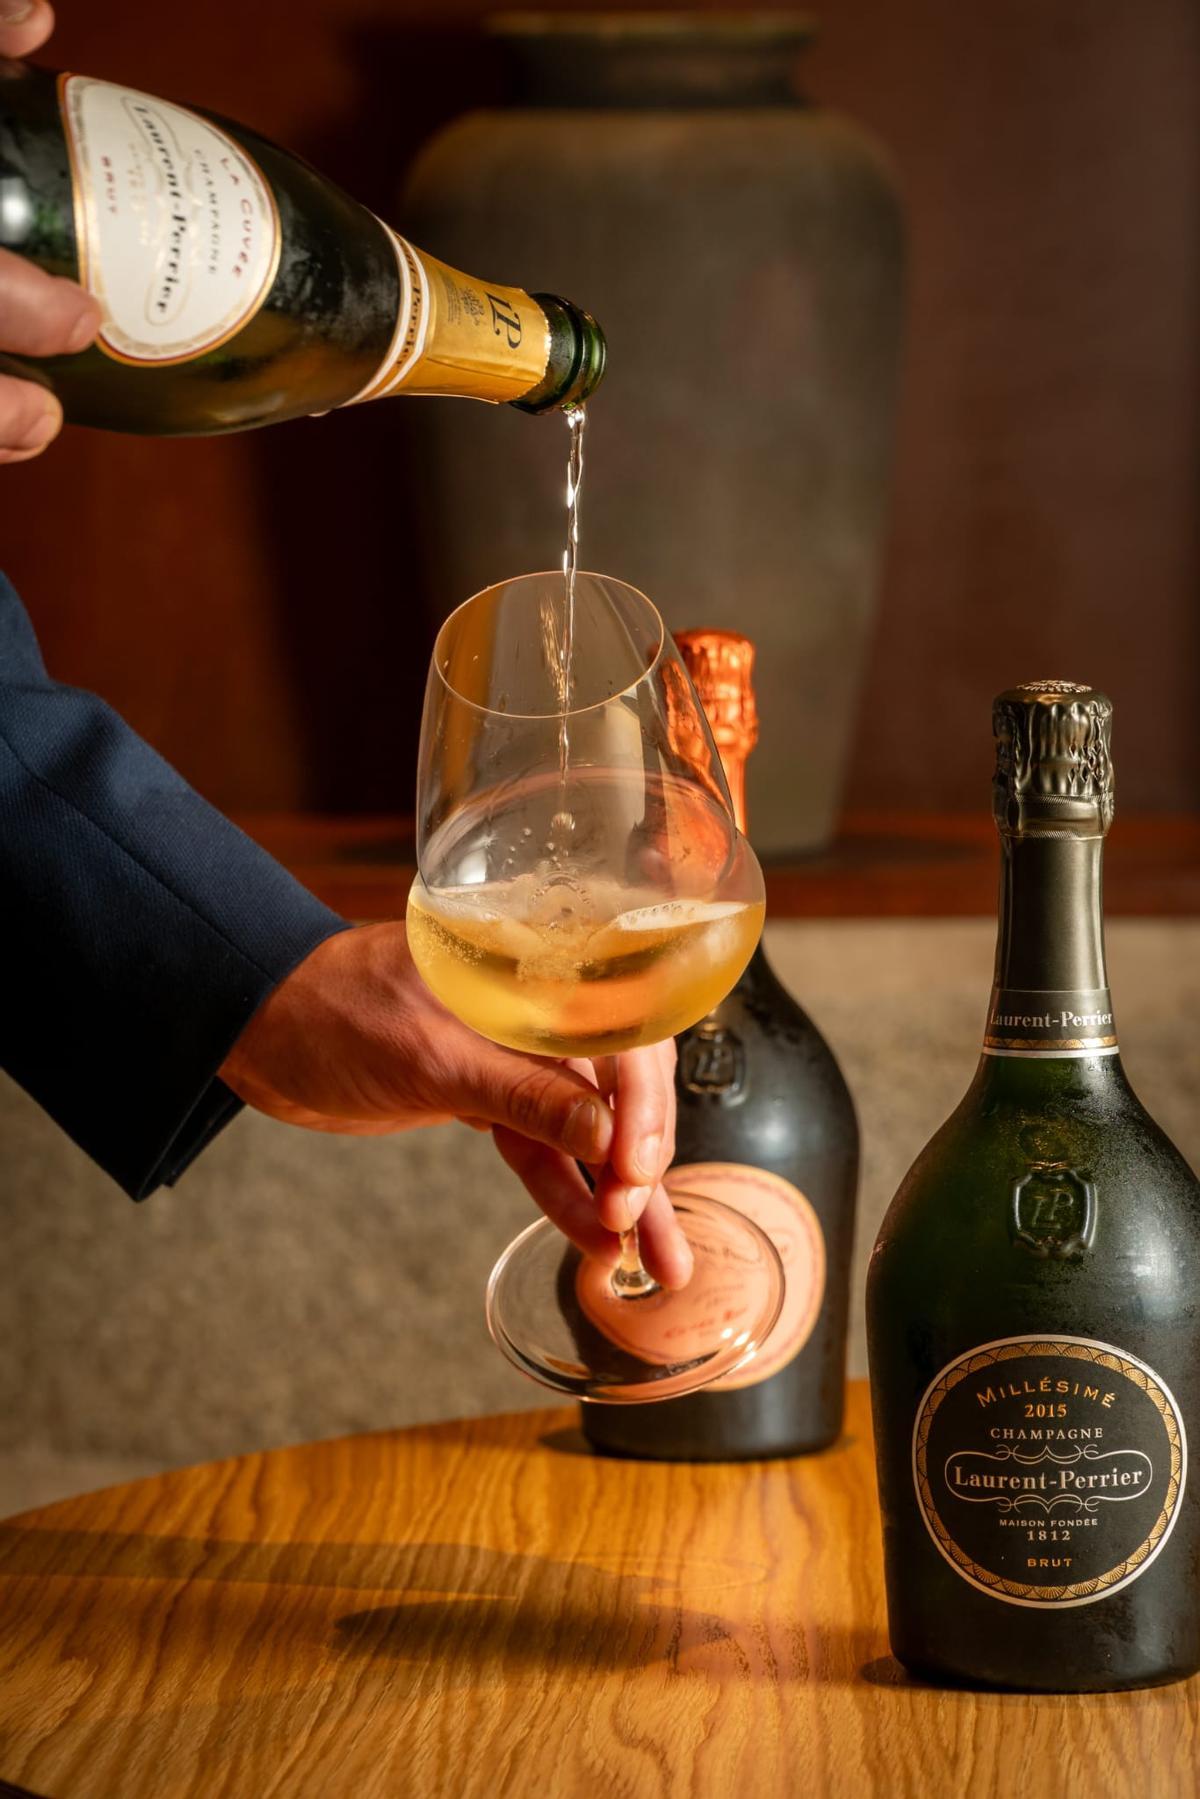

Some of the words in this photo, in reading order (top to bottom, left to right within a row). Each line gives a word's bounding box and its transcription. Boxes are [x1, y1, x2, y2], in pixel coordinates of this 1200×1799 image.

[220, 157, 241, 186] LA
[133, 105, 188, 313] Laurent-Perrier
[194, 148, 226, 275] CHAMPAGNE
[990, 1008, 1113, 1028] Laurent-Perrier
[976, 1377, 1117, 1409] MILLÉSIMÉ
[1024, 1403, 1067, 1418] 2015
[990, 1427, 1104, 1439] CHAMPAGNE
[954, 1466, 1143, 1490] Laurent-Perrier
[999, 1518, 1046, 1527] MAISON
[1050, 1517, 1099, 1527] FONDÉE
[1027, 1530, 1071, 1541] 1812
[1027, 1557, 1073, 1568] BRUT
